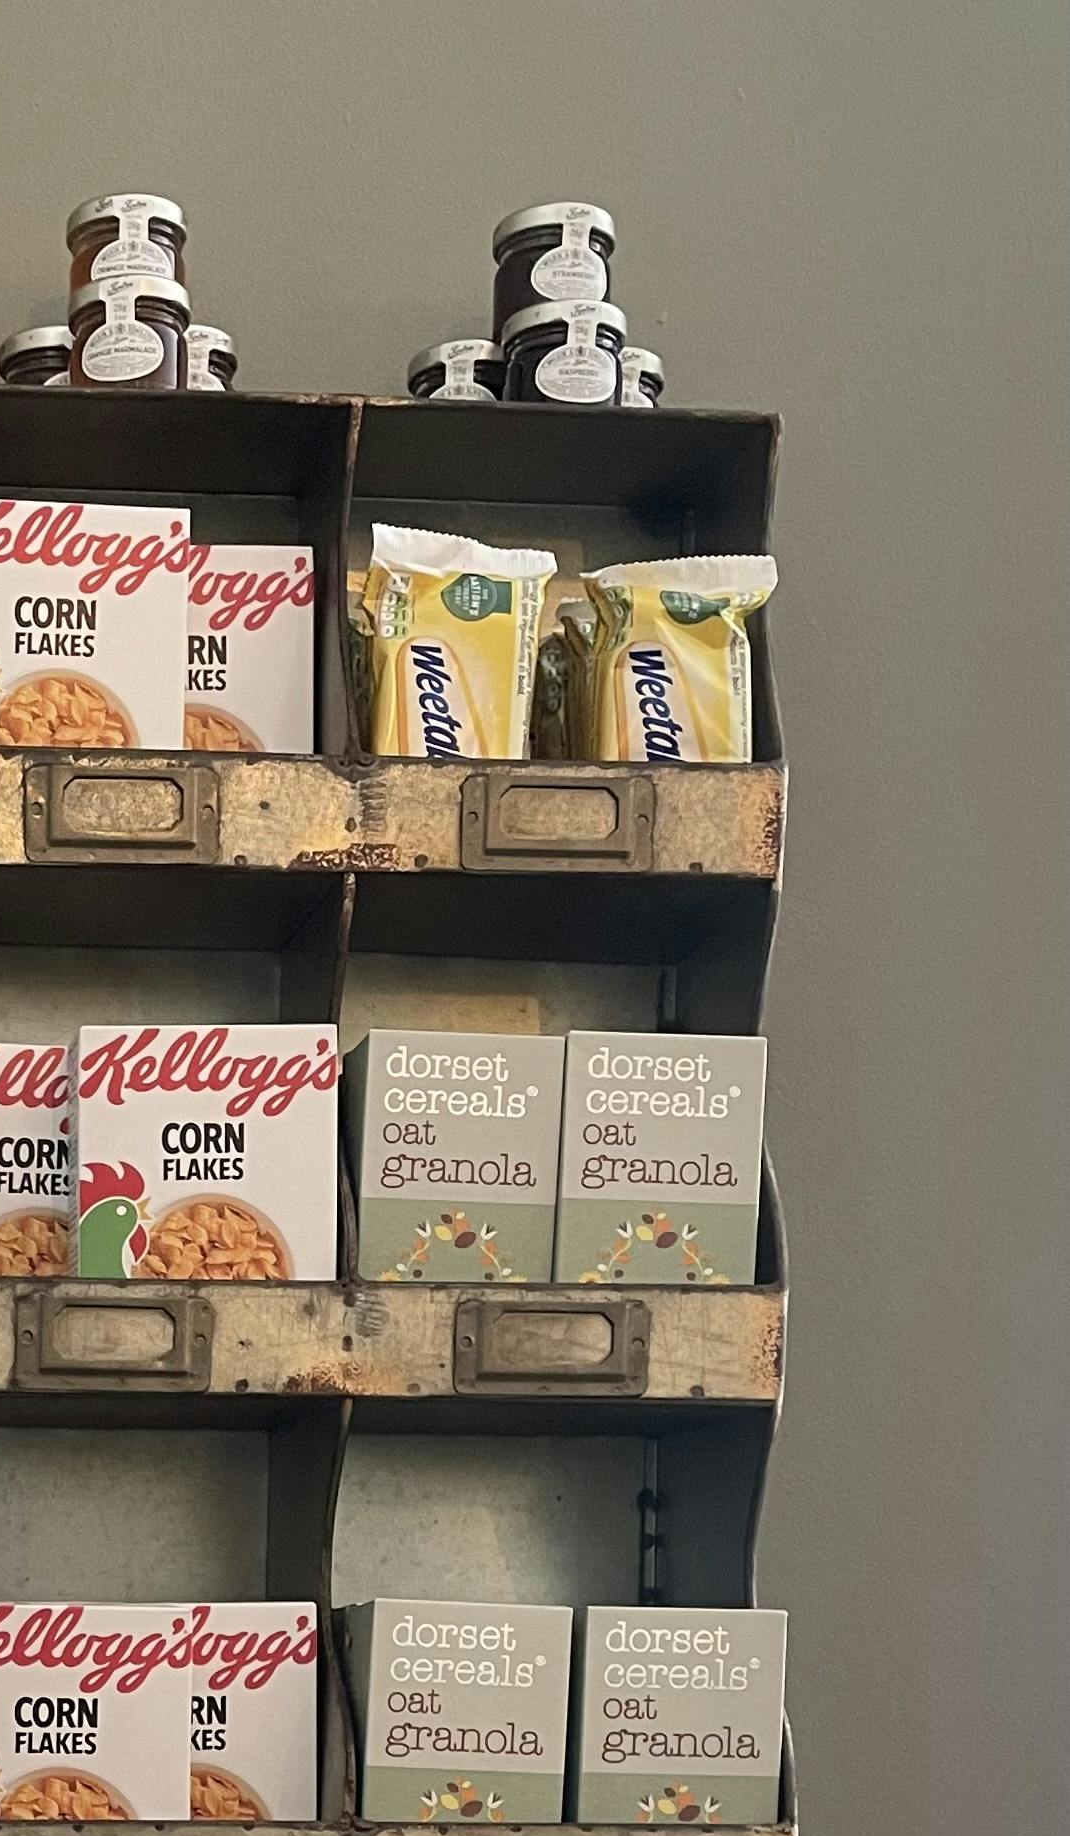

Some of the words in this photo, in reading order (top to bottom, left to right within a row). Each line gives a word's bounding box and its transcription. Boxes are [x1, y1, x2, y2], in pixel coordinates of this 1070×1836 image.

[14, 596, 97, 630] CORN
[14, 632, 95, 658] FLAKES
[79, 1028, 338, 1117] Kellogg's
[386, 1045, 509, 1080] dorset
[587, 1047, 711, 1082] dorset
[161, 1122, 245, 1154] CORN
[382, 1120, 436, 1145] oat
[583, 1121, 637, 1146] oat
[162, 1158, 244, 1181] FLAKES
[380, 1153, 537, 1188] granola
[581, 1153, 738, 1189] granola
[392, 1615, 516, 1653] dorset
[605, 1621, 730, 1655] dorset
[14, 1696, 98, 1728] CORN
[387, 1689, 441, 1714] oat
[603, 1694, 657, 1720] oat
[15, 1732, 97, 1755] FLAKES
[385, 1722, 543, 1758] granola
[601, 1727, 760, 1763] granola
